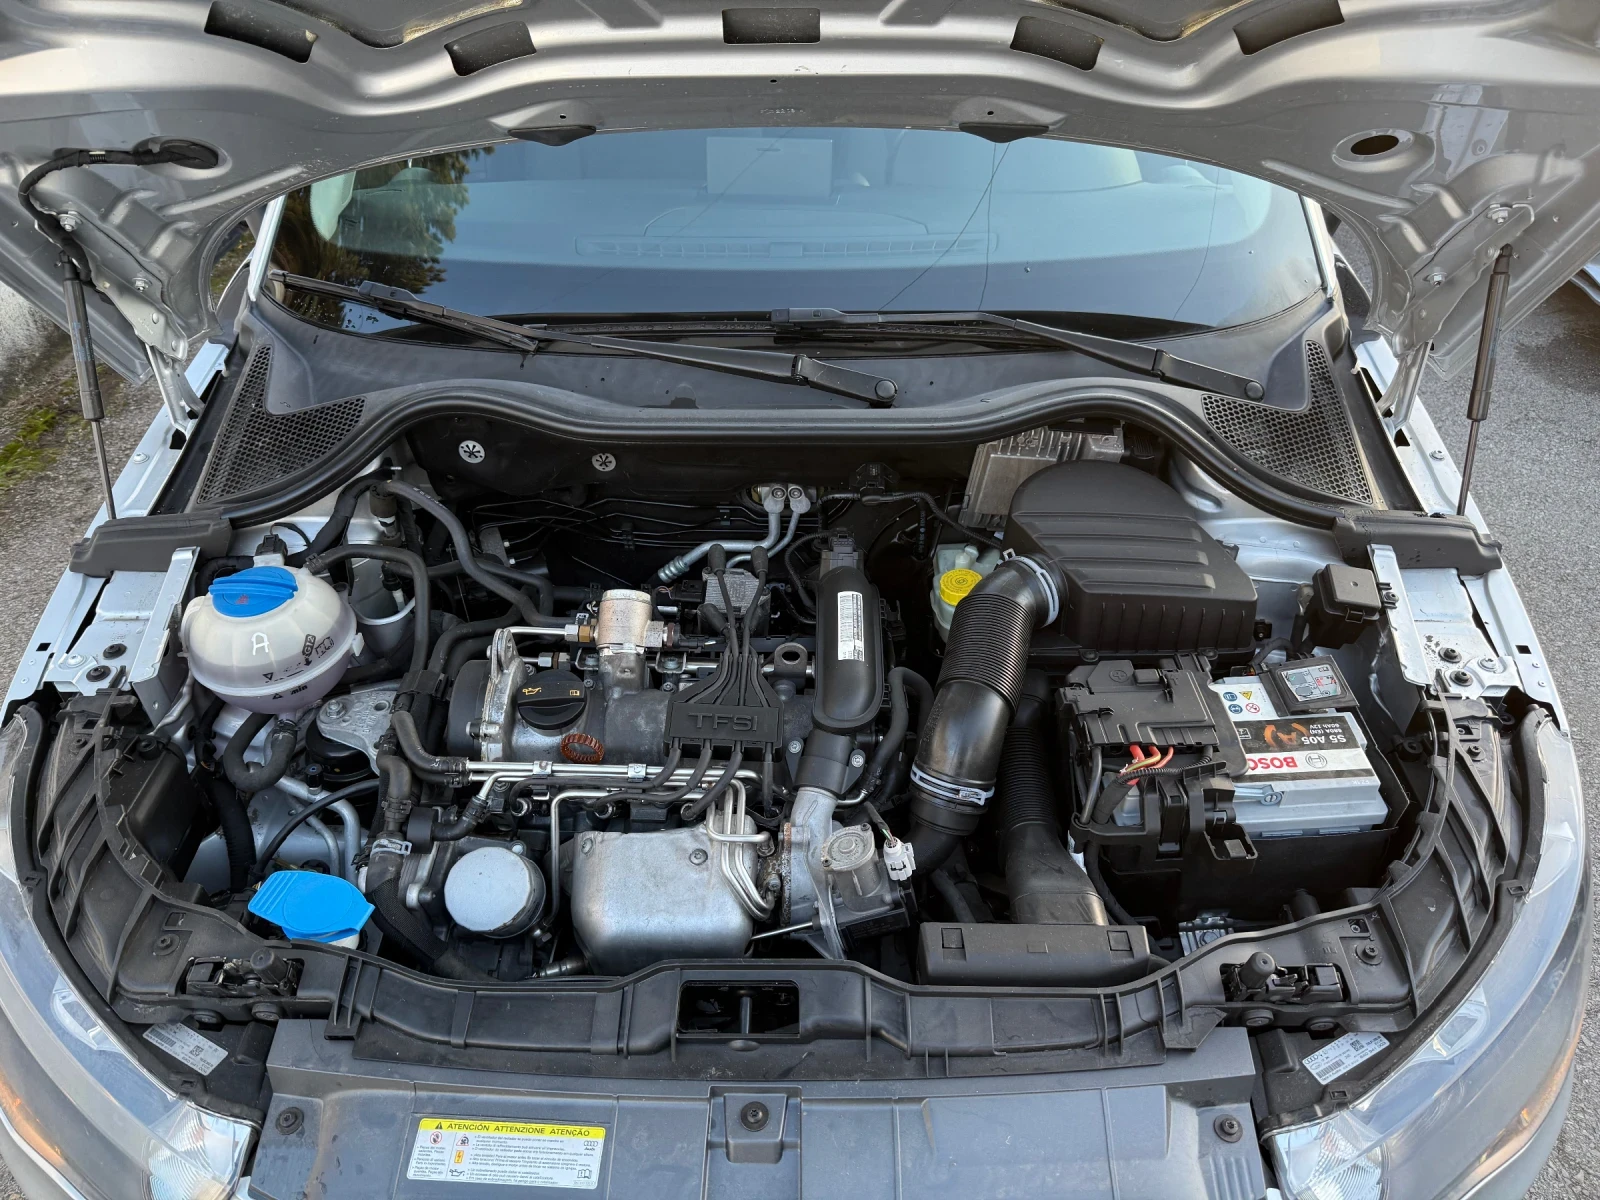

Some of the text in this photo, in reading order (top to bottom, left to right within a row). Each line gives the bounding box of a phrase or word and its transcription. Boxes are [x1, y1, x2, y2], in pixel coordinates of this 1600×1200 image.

[251, 632, 269, 655] A
[304, 635, 315, 654] G12
[290, 685, 308, 695] min
[688, 712, 758, 731] TFSI
[1301, 734, 1347, 745] S5 A05
[1246, 756, 1298, 771] BOSC
[446, 1123, 590, 1137] ATENCIÓN ATTENZIONE ATENÇÃO
